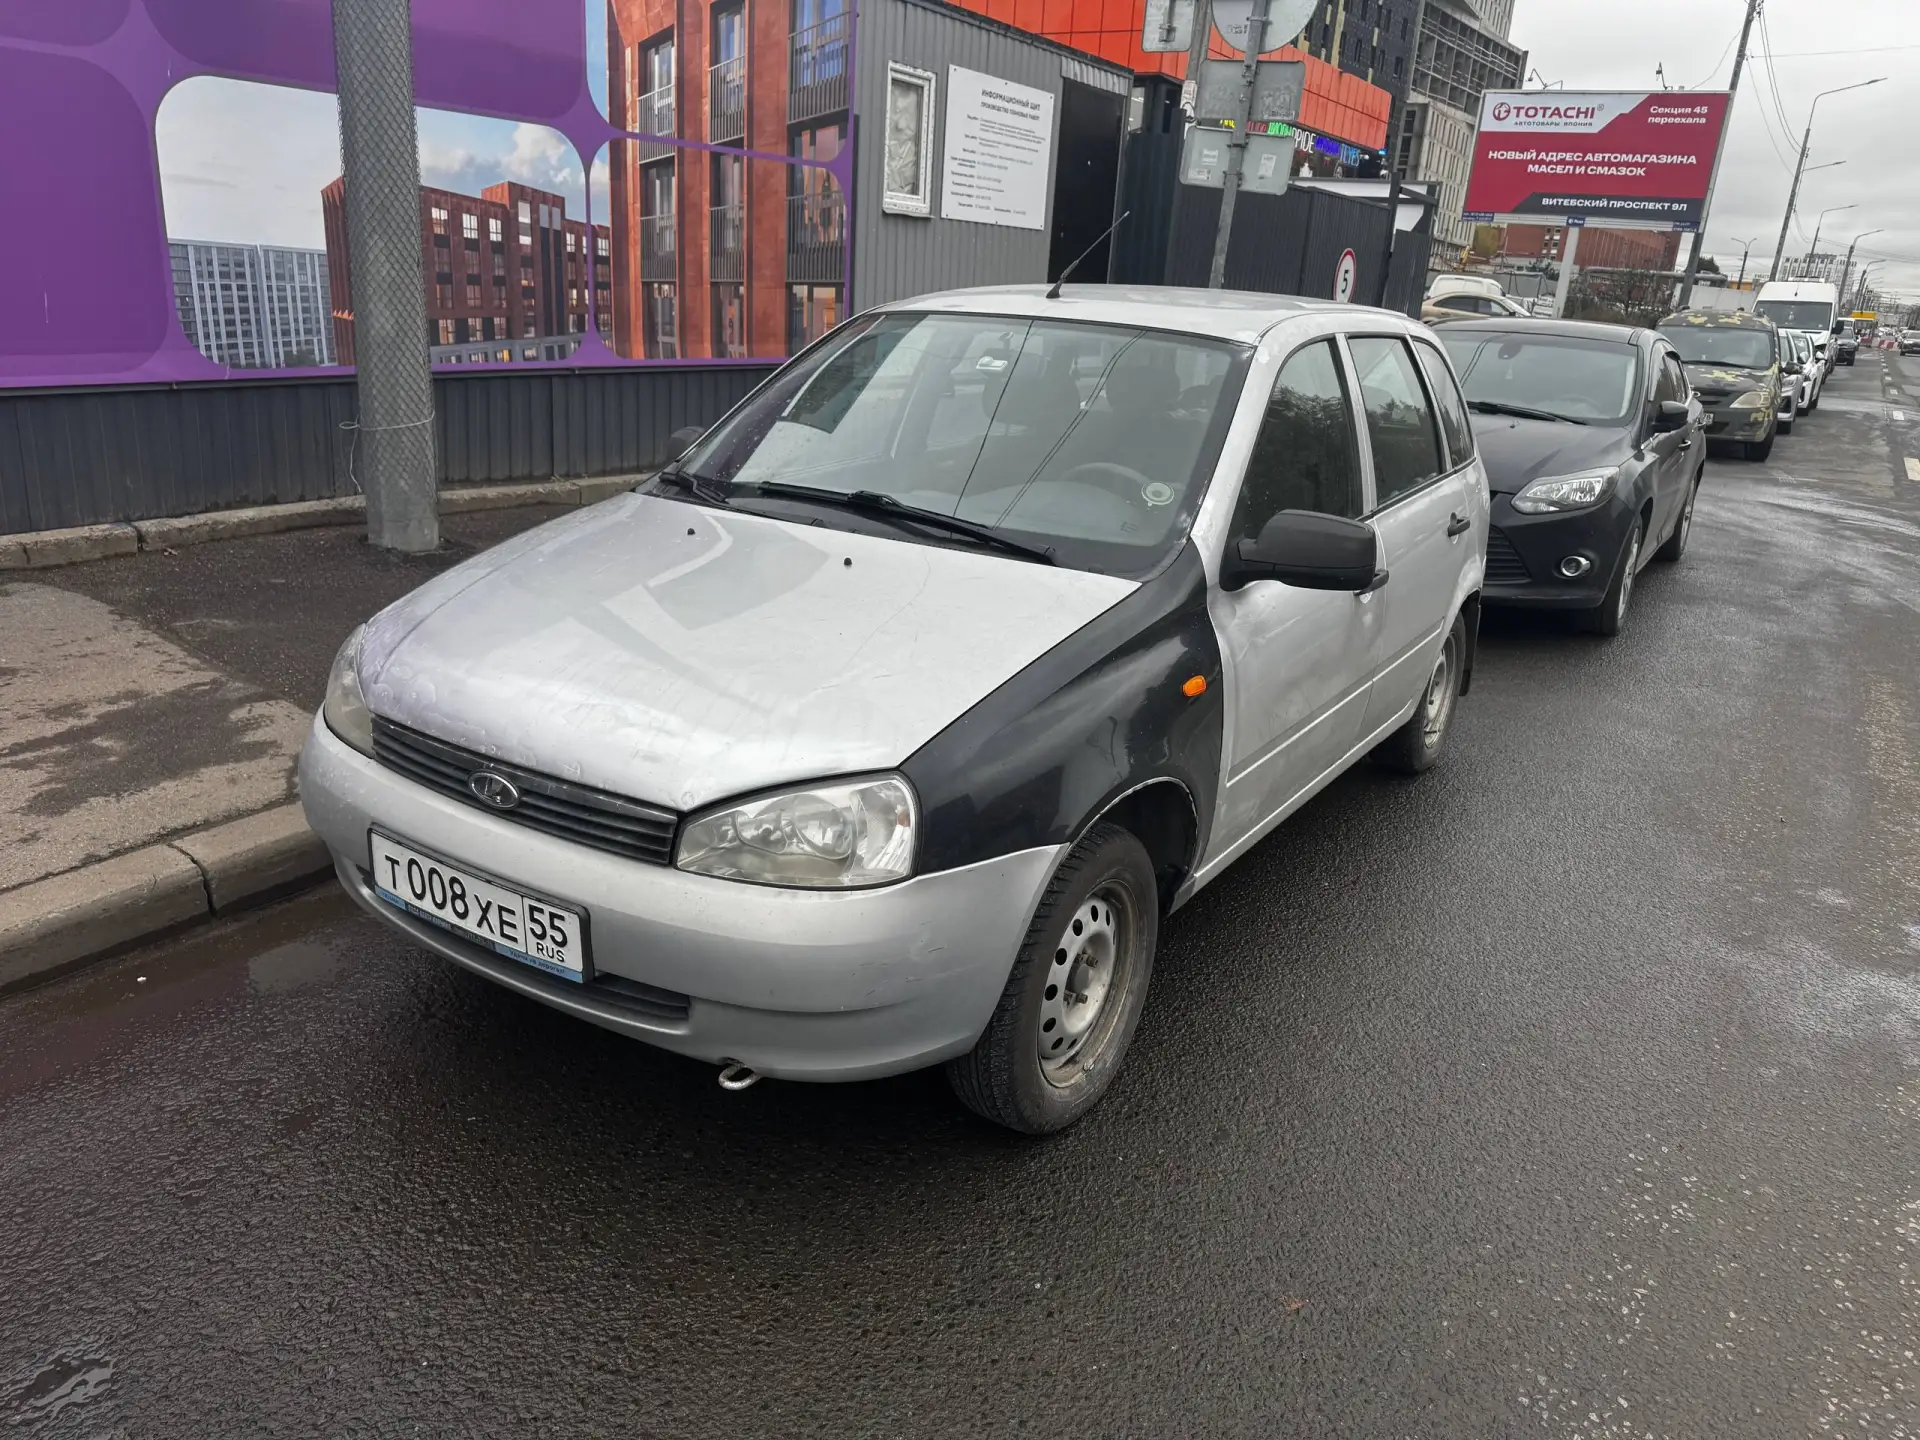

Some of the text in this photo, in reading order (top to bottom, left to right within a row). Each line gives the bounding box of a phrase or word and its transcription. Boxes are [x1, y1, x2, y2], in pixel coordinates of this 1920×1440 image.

[981, 88, 1029, 108] ИНФОРМАЦИОННЫЙ
[1513, 106, 1596, 119] TOTACHI
[1650, 105, 1708, 115] Секция 45
[1648, 116, 1706, 125] переехала
[1488, 149, 1697, 165] НОВЫЙ АДРЕС АВТОМАГАЗИНА
[1527, 164, 1647, 176] МАСЕЛ И СМАЗОК
[1542, 198, 1688, 211] ВИТЕБСКИЙ ПРОСПЕКТ 9Л
[1341, 269, 1349, 294] 5
[528, 903, 568, 948] 55
[536, 941, 565, 963] RUS
